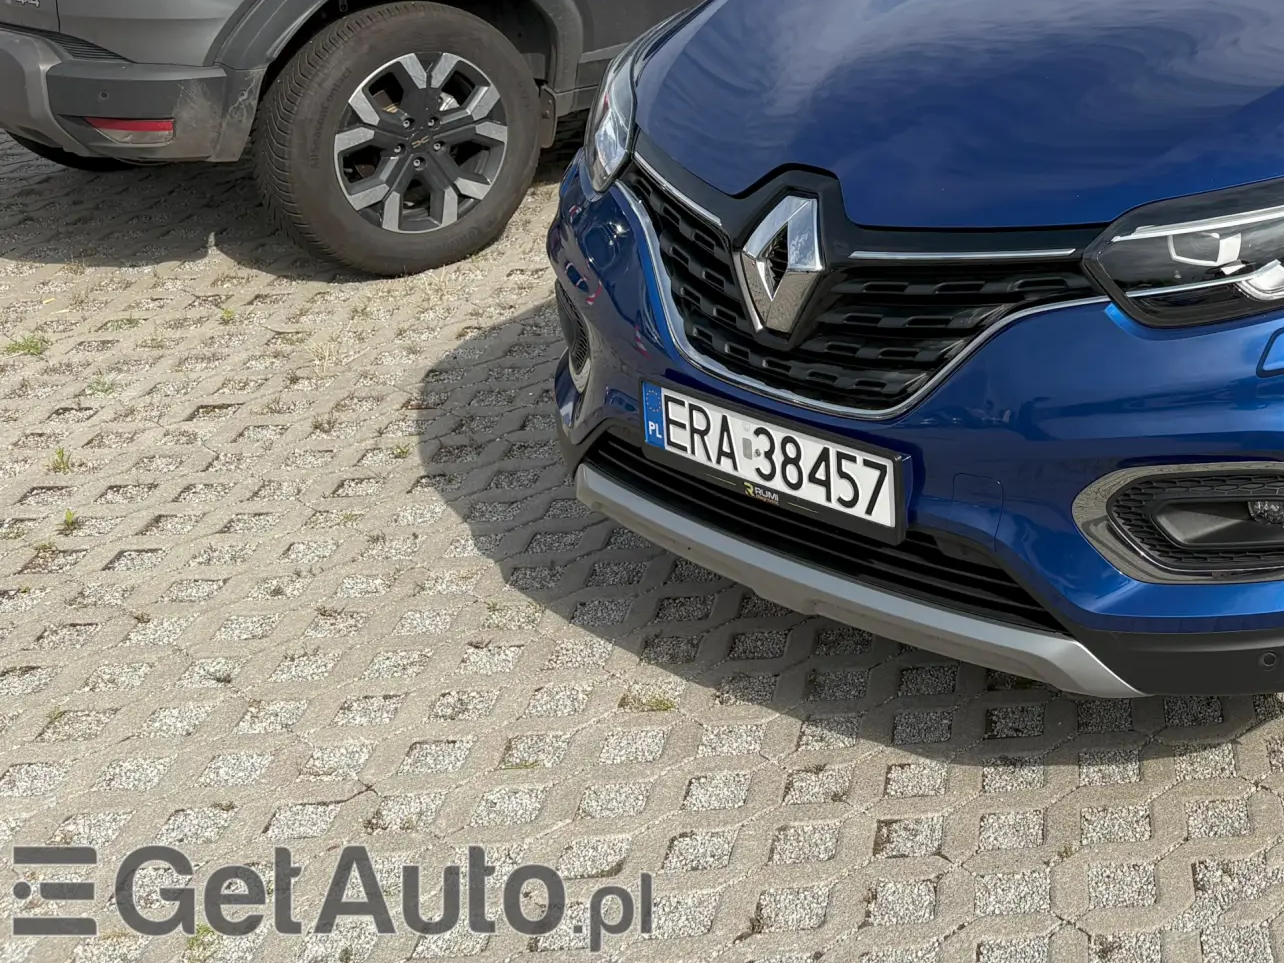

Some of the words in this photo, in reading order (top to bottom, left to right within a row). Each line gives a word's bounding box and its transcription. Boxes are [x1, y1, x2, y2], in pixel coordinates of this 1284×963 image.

[648, 420, 662, 439] PL
[663, 393, 740, 473] ERA
[753, 426, 888, 517] 38457
[754, 486, 779, 502] RUMI
